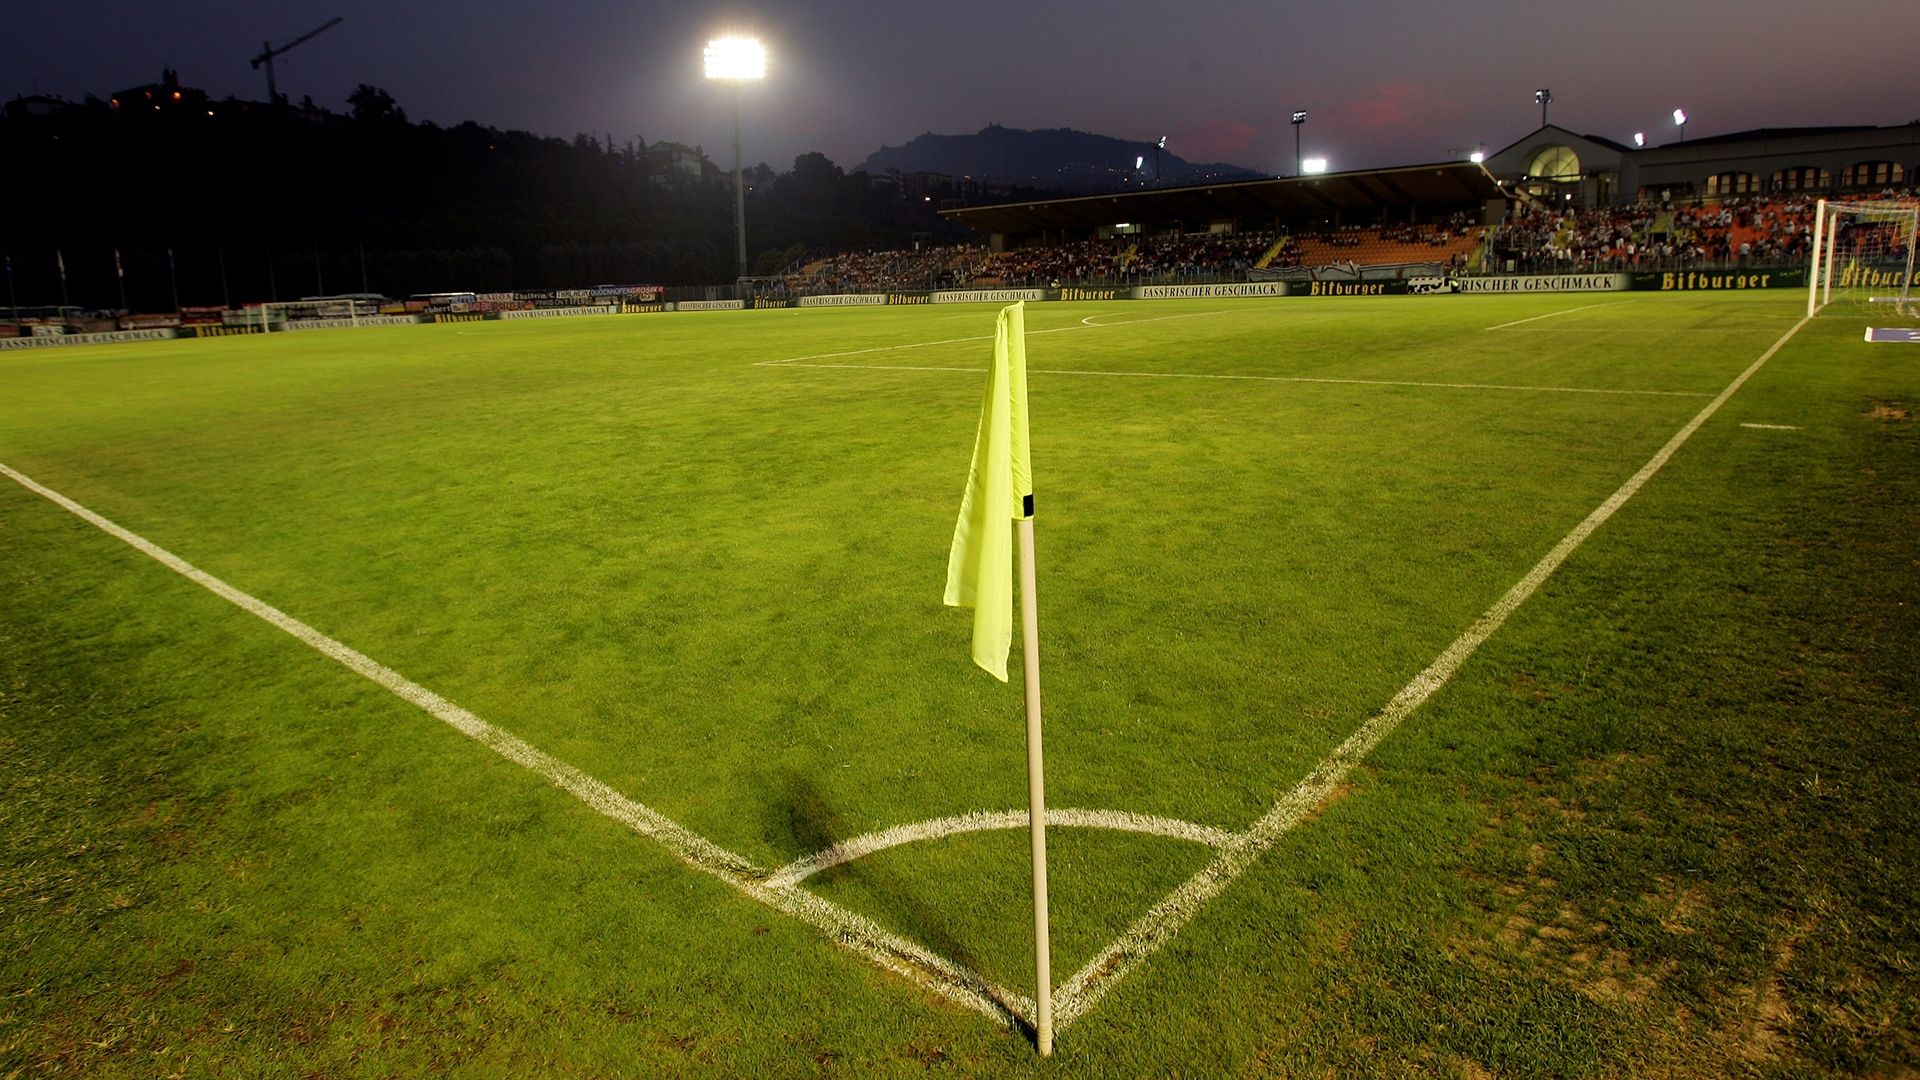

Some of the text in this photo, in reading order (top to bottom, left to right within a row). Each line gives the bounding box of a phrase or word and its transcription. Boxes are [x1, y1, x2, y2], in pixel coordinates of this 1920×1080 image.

[1524, 276, 1613, 290] GESCHMACK
[1660, 272, 1770, 290] Bitburger
[1061, 288, 1115, 300] Bitburger
[1143, 284, 1277, 298] FASSFRISCHER GESCHMACK
[1310, 281, 1385, 296] Bitburger
[803, 295, 882, 305] FASSFRISCHER GESCHMACK
[888, 294, 929, 305] Bitburger
[938, 290, 1037, 301] FASSFRISCHER GESCHMACK
[621, 304, 662, 313] Bitburger
[754, 299, 787, 309] Bitburger
[507, 305, 606, 319] FASSFRISCHER GESCHMACK
[358, 316, 412, 327] GESCHMACK
[93, 330, 165, 344] GESCHMACK
